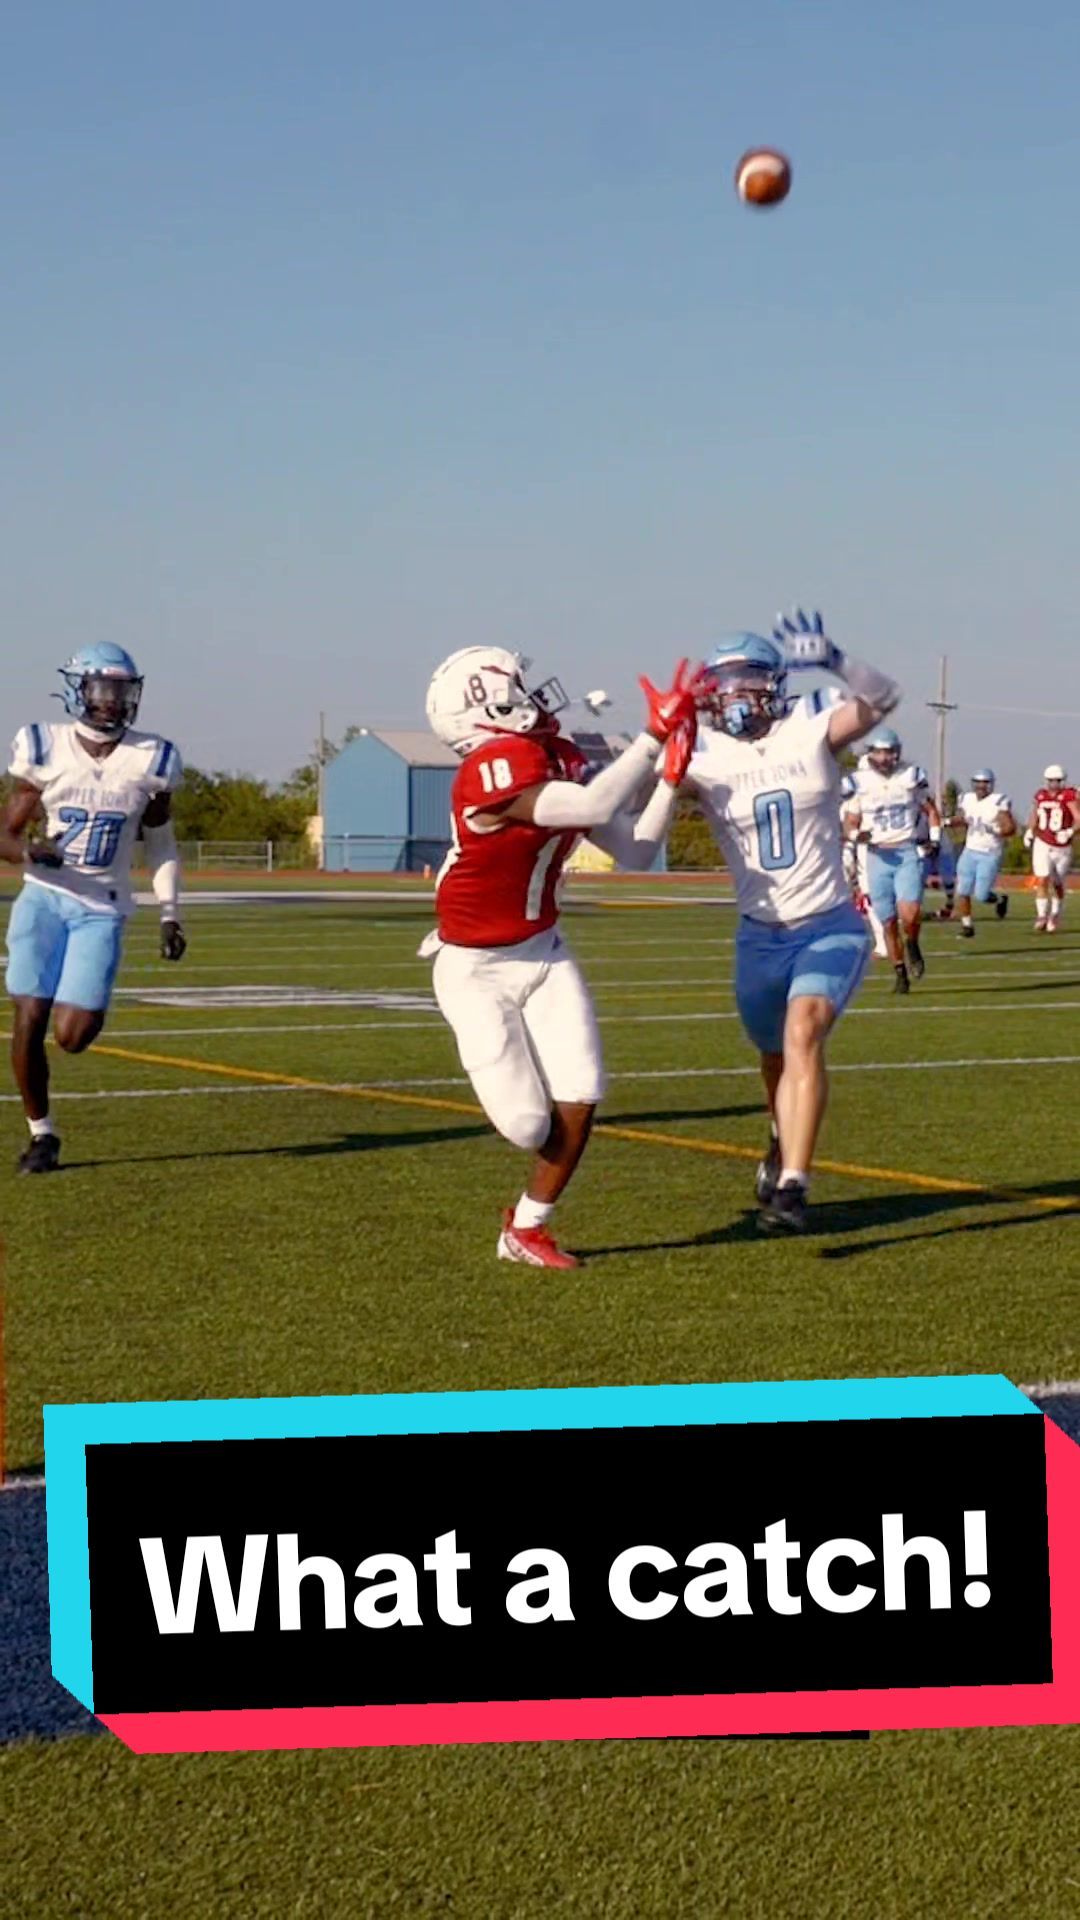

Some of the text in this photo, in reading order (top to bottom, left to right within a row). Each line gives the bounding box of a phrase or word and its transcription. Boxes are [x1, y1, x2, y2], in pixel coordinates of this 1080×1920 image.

[478, 757, 514, 793] 18
[58, 806, 127, 867] 20
[753, 788, 796, 871] 0
